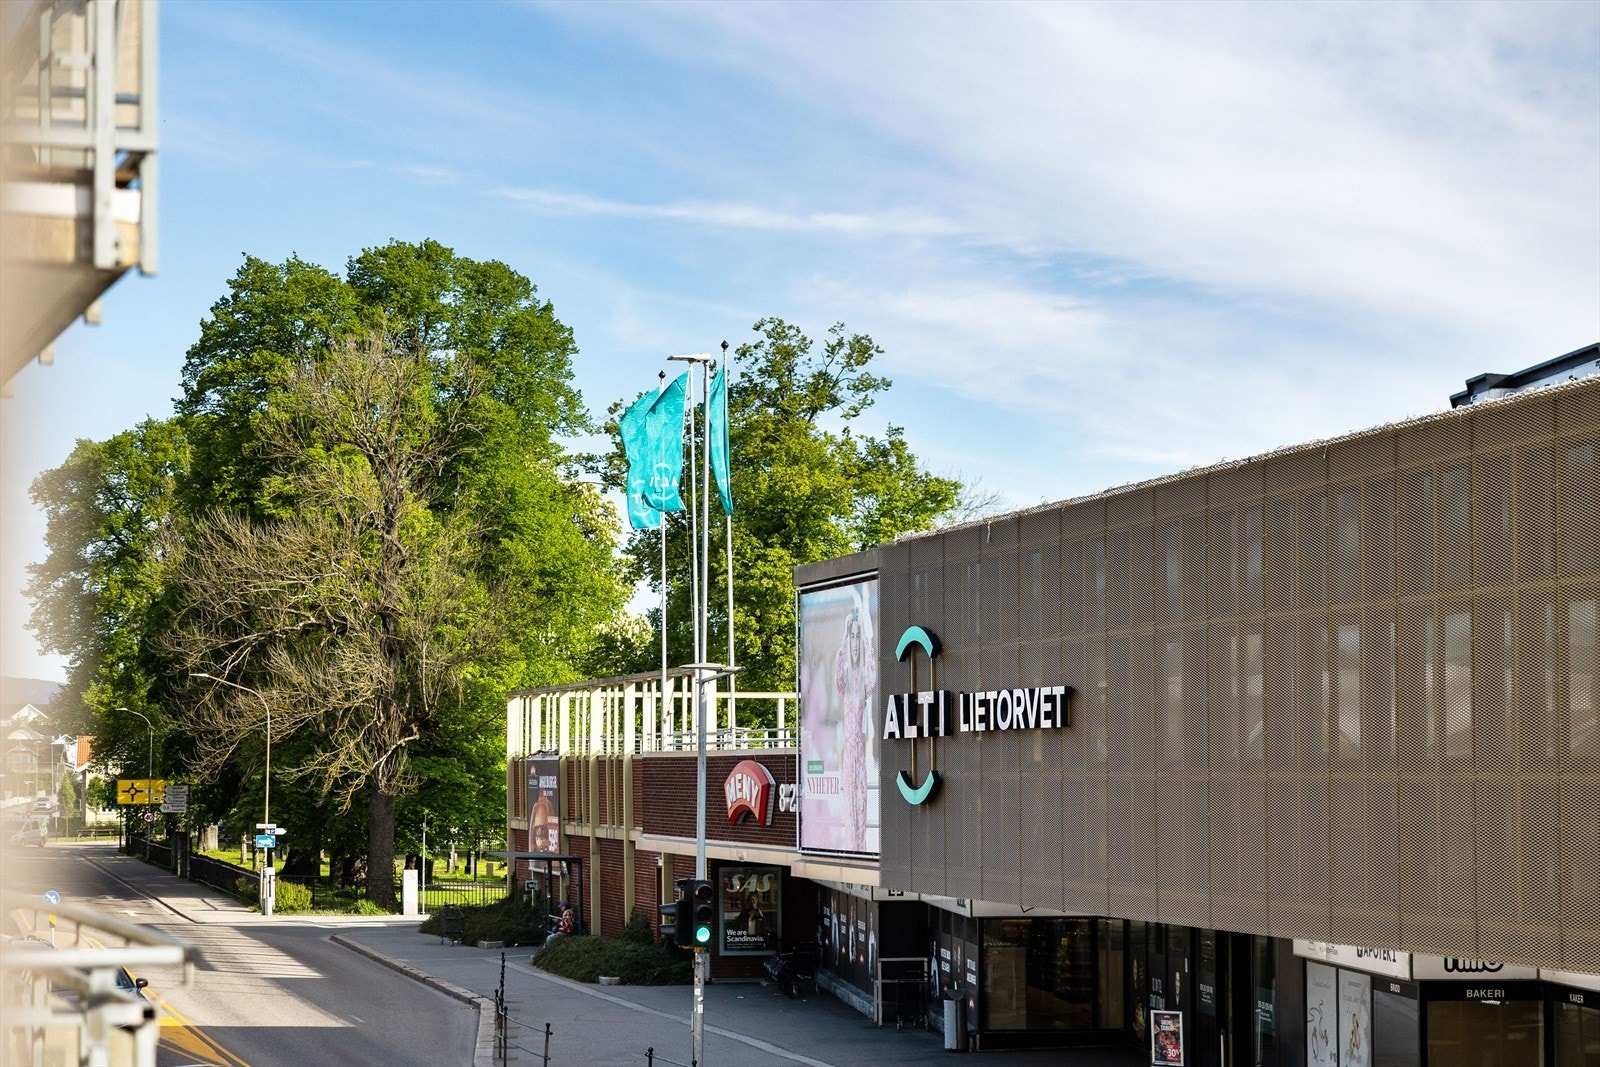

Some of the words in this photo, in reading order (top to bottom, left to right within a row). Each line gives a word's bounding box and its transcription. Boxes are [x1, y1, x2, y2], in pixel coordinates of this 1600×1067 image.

[883, 690, 945, 739] ALTI
[959, 686, 1066, 732] LIETORVET
[726, 773, 760, 809] MENY
[807, 777, 840, 795] NYHETER
[726, 873, 775, 893] SAS
[1466, 989, 1505, 998] BAKERI
